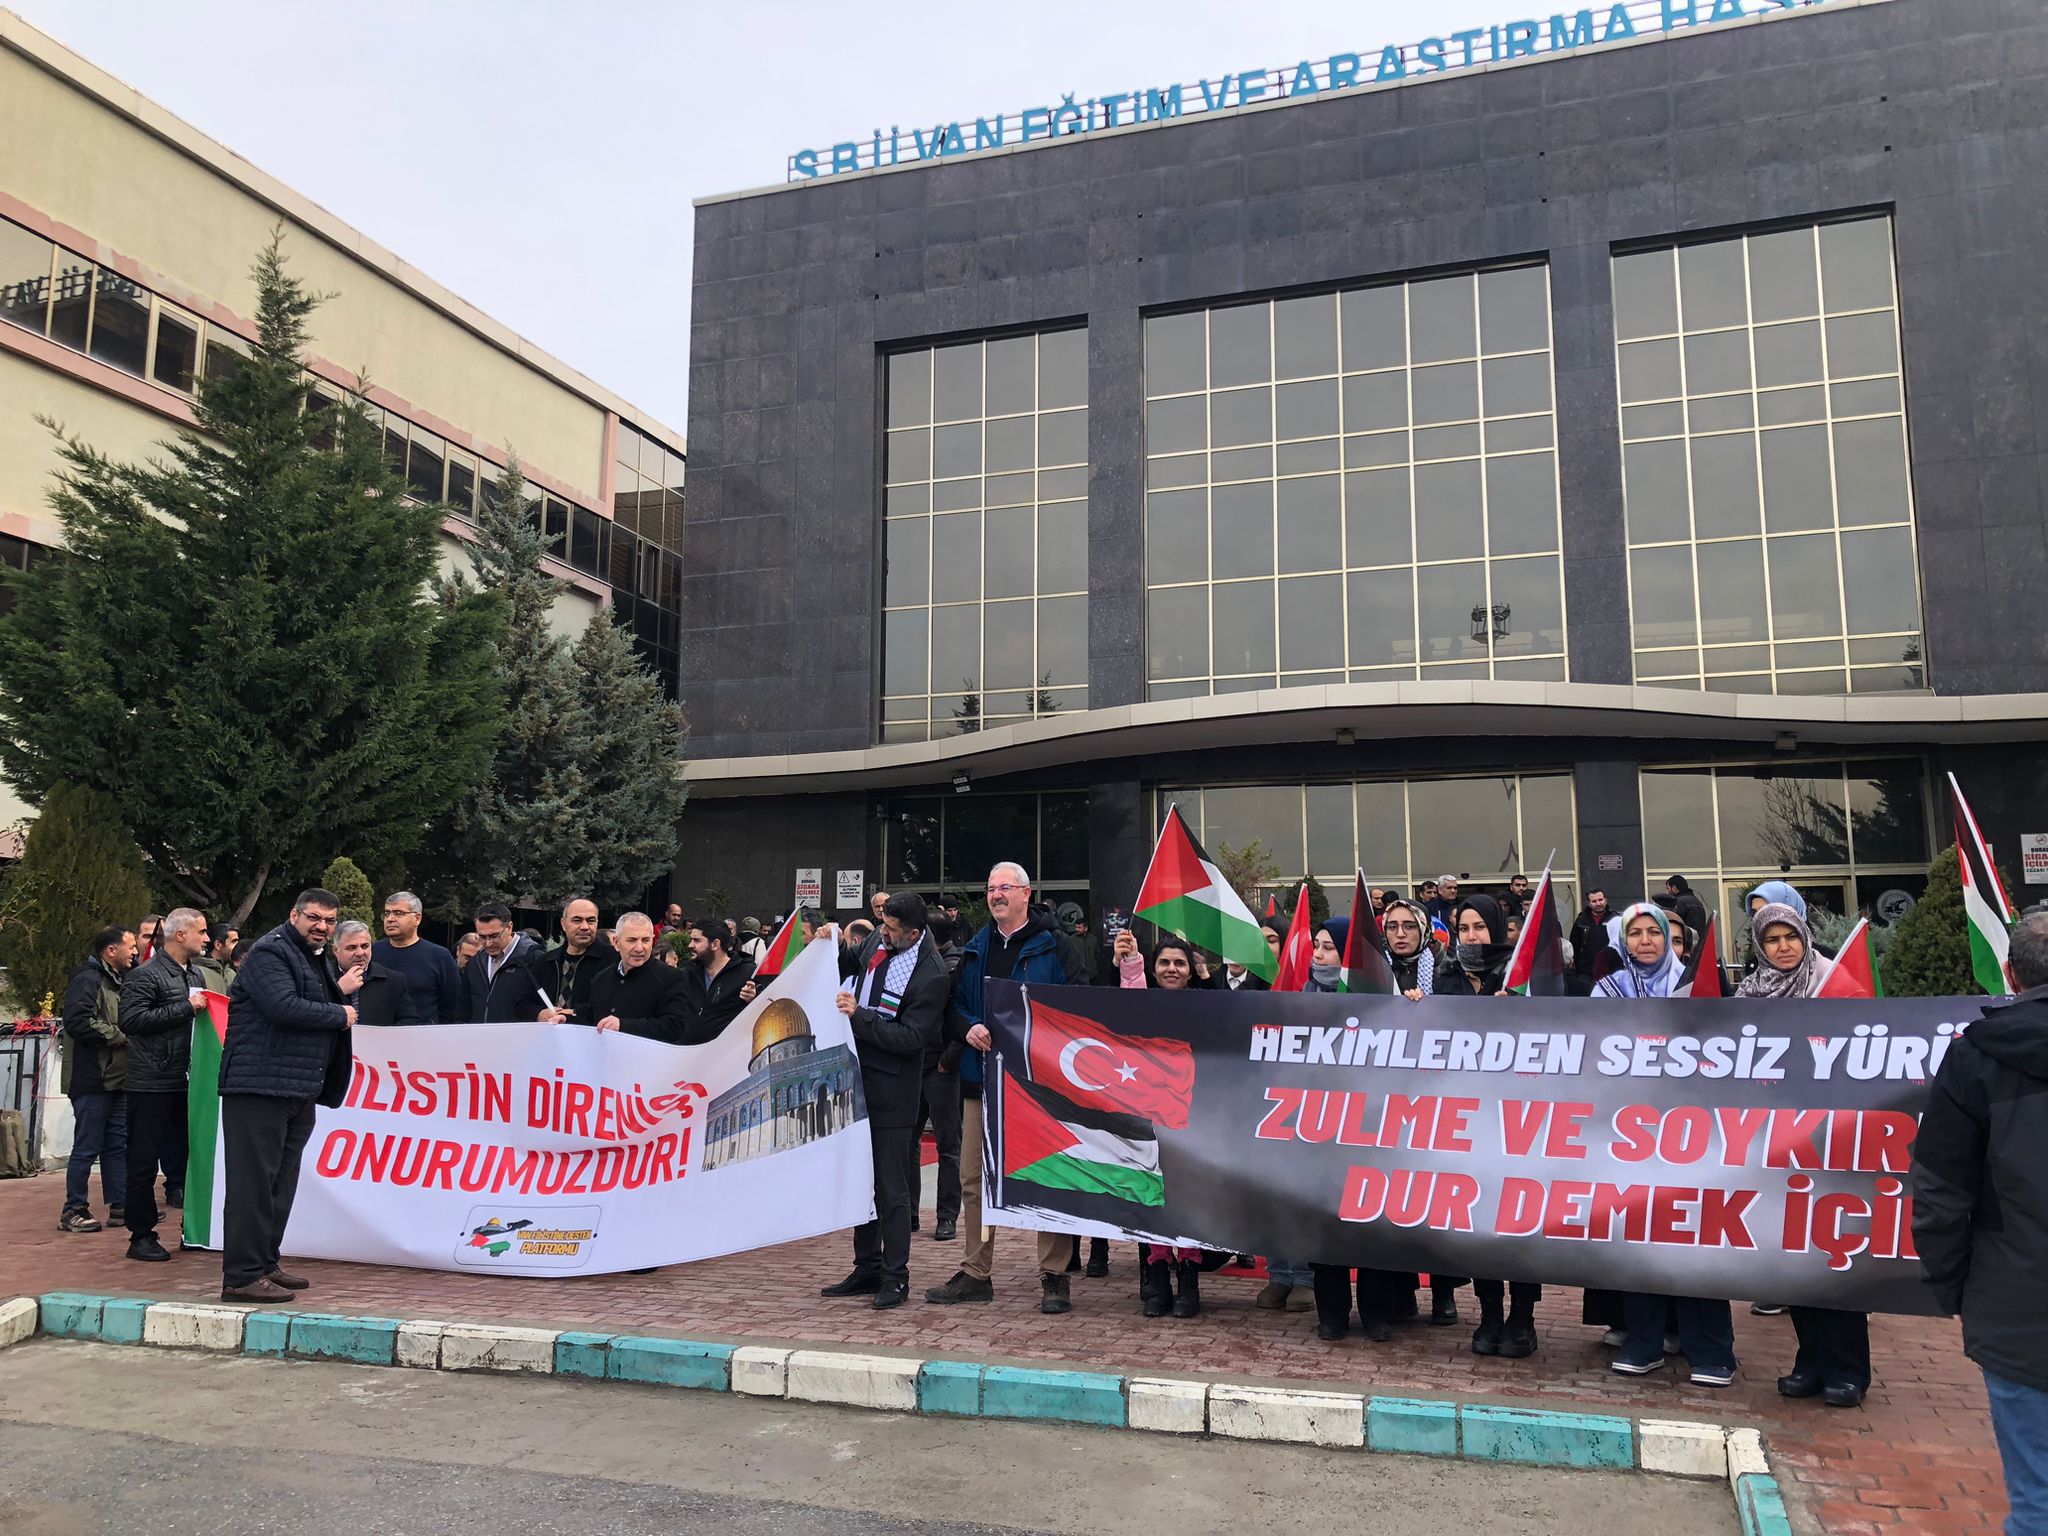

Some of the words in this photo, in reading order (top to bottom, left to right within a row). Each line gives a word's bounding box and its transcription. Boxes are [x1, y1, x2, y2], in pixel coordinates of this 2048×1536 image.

[1249, 1016, 1586, 1075] HEKİMLERDEN
[1597, 1024, 1791, 1080] SESSİZ
[344, 1054, 512, 1124] İLİSTİN
[315, 1126, 692, 1196] ONURUMUZDUR!
[1254, 1086, 1481, 1153] ZULME
[1498, 1099, 1595, 1159] VE
[1607, 1103, 1923, 1174] SOYKIR
[1338, 1164, 1481, 1233] DUR
[1494, 1176, 1763, 1251] DEMEK
[519, 1241, 580, 1255] PLATFORMU
